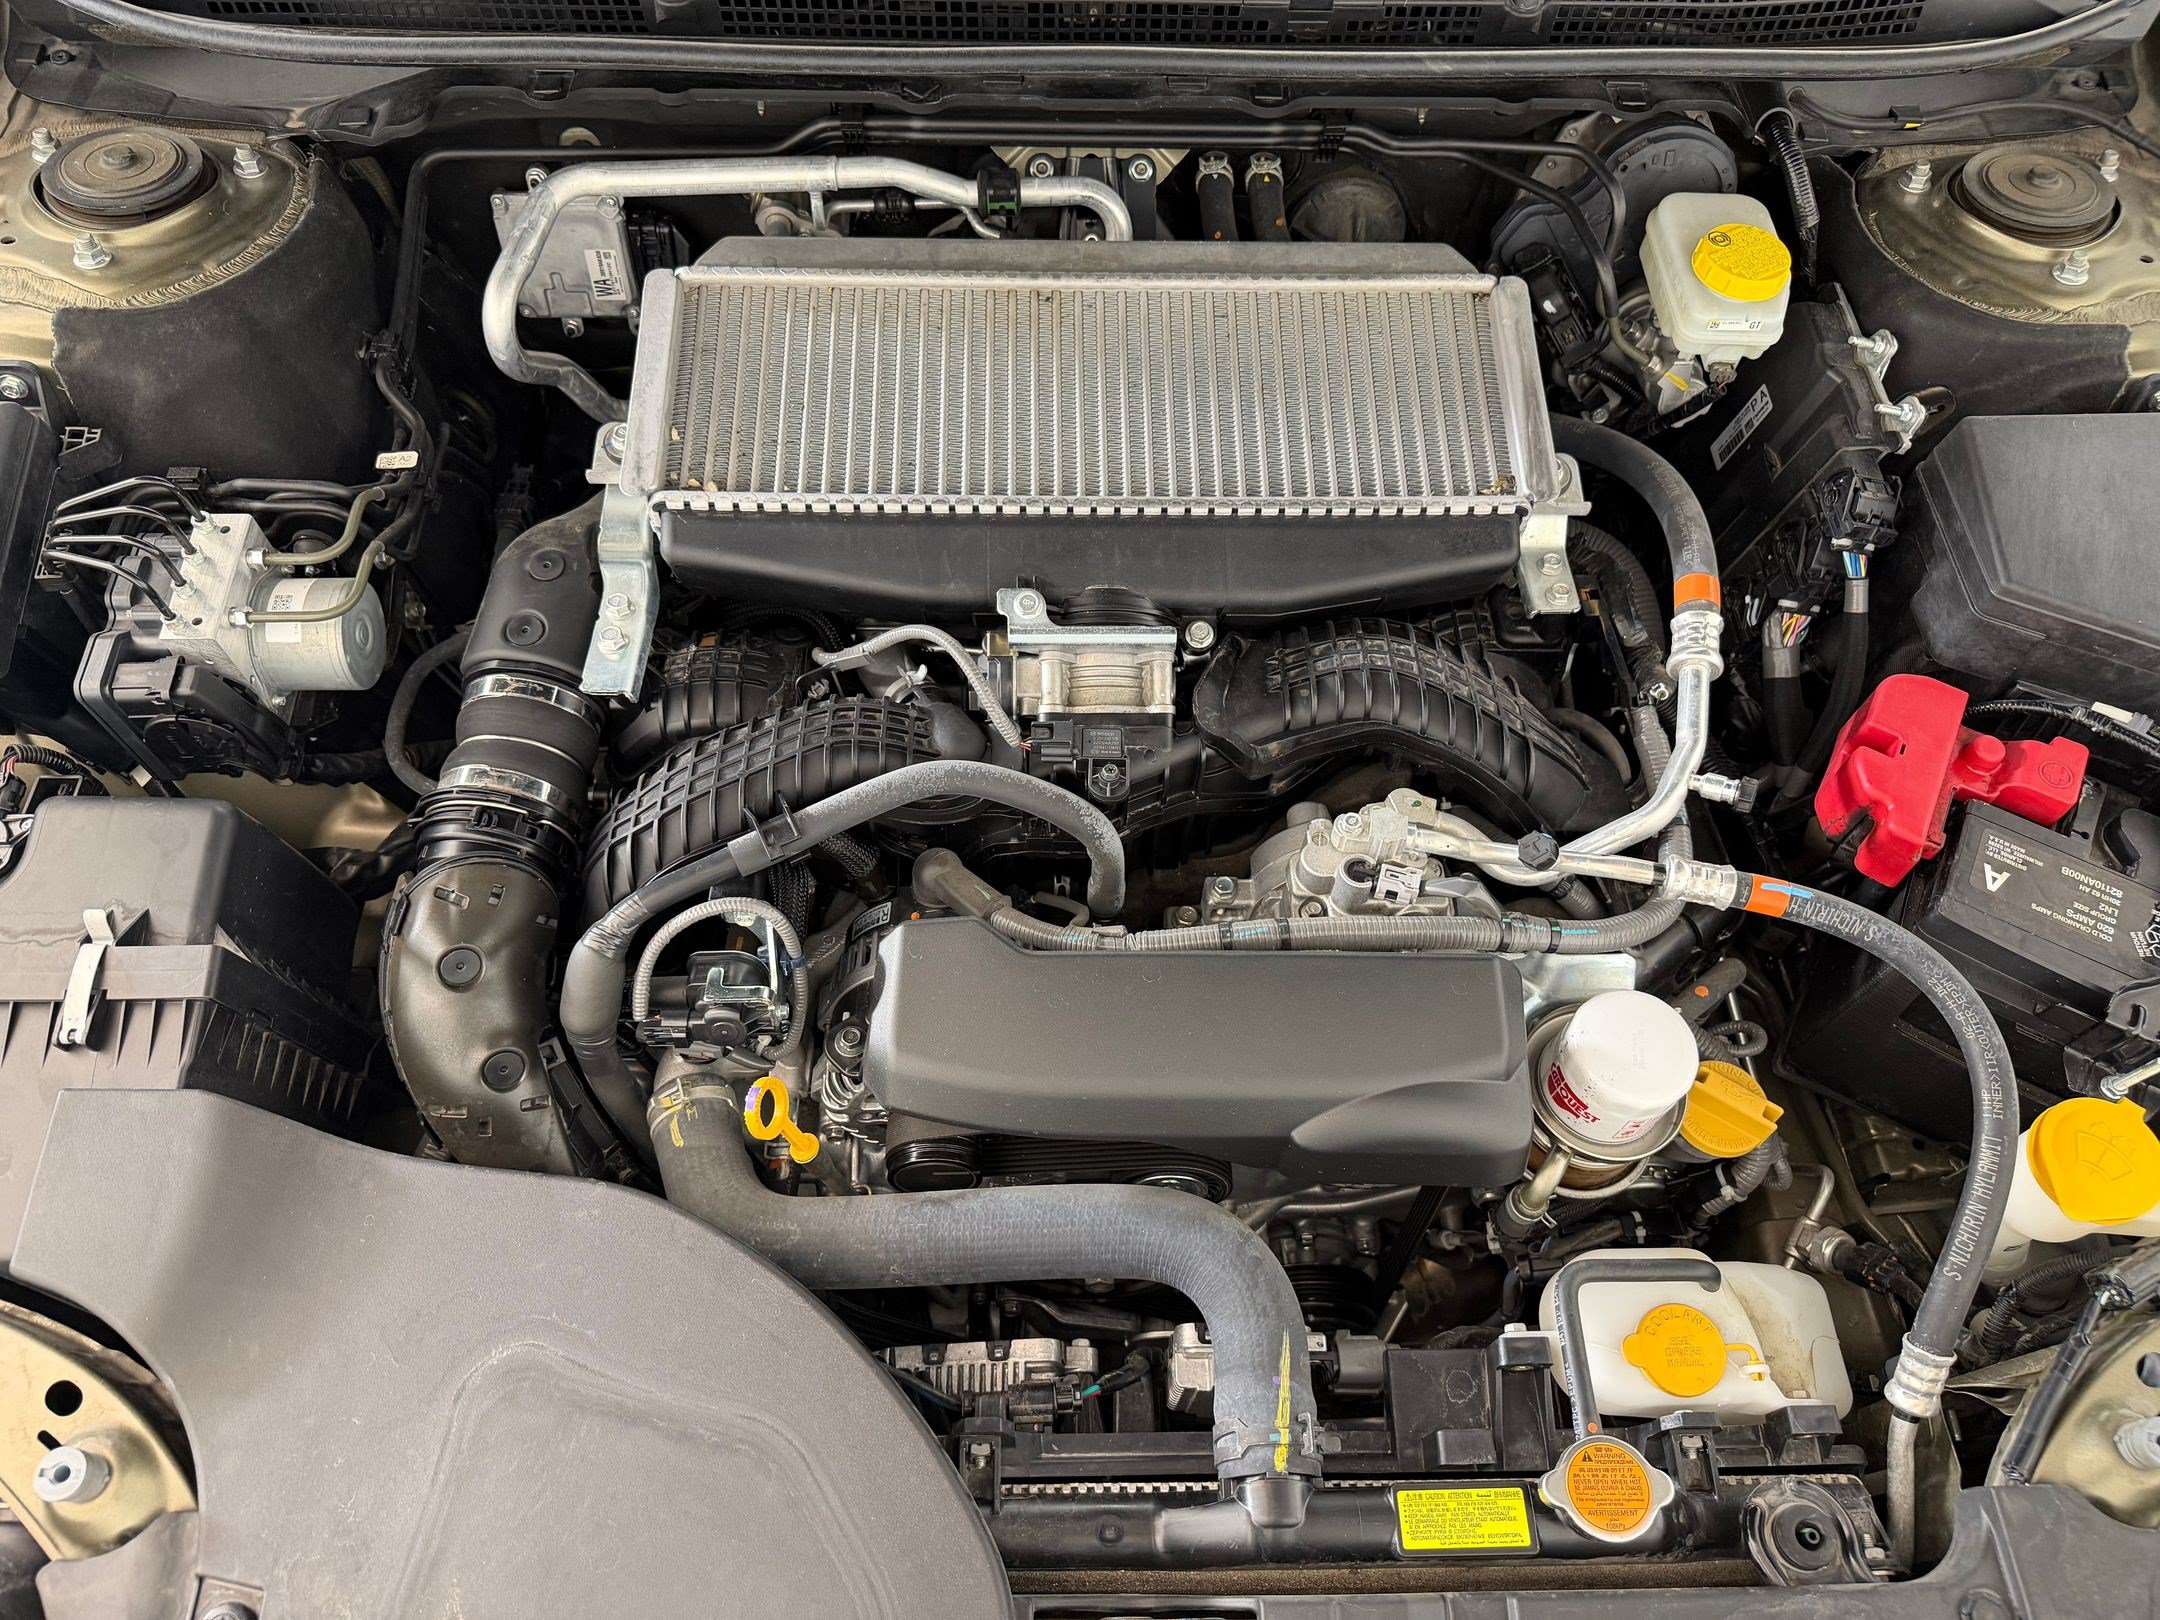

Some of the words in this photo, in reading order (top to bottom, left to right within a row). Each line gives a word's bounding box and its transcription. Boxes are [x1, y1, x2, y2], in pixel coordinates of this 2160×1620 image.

[594, 279, 612, 297] WA
[1983, 862, 2011, 892] A
[2061, 866, 2123, 898] 82110AN00B
[2031, 903, 2052, 917] AMPS
[2073, 901, 2090, 914] SIZE
[2098, 902, 2119, 916] LN2
[2053, 912, 2091, 934] CRANKING
[2066, 908, 2096, 926] AMPS
[2090, 909, 2117, 925] GROUP
[2092, 928, 2113, 943] COLD
[2096, 922, 2115, 935] 620
[1551, 1062, 1600, 1122] CARQUEST
[1645, 1309, 1714, 1336] COOLANT
